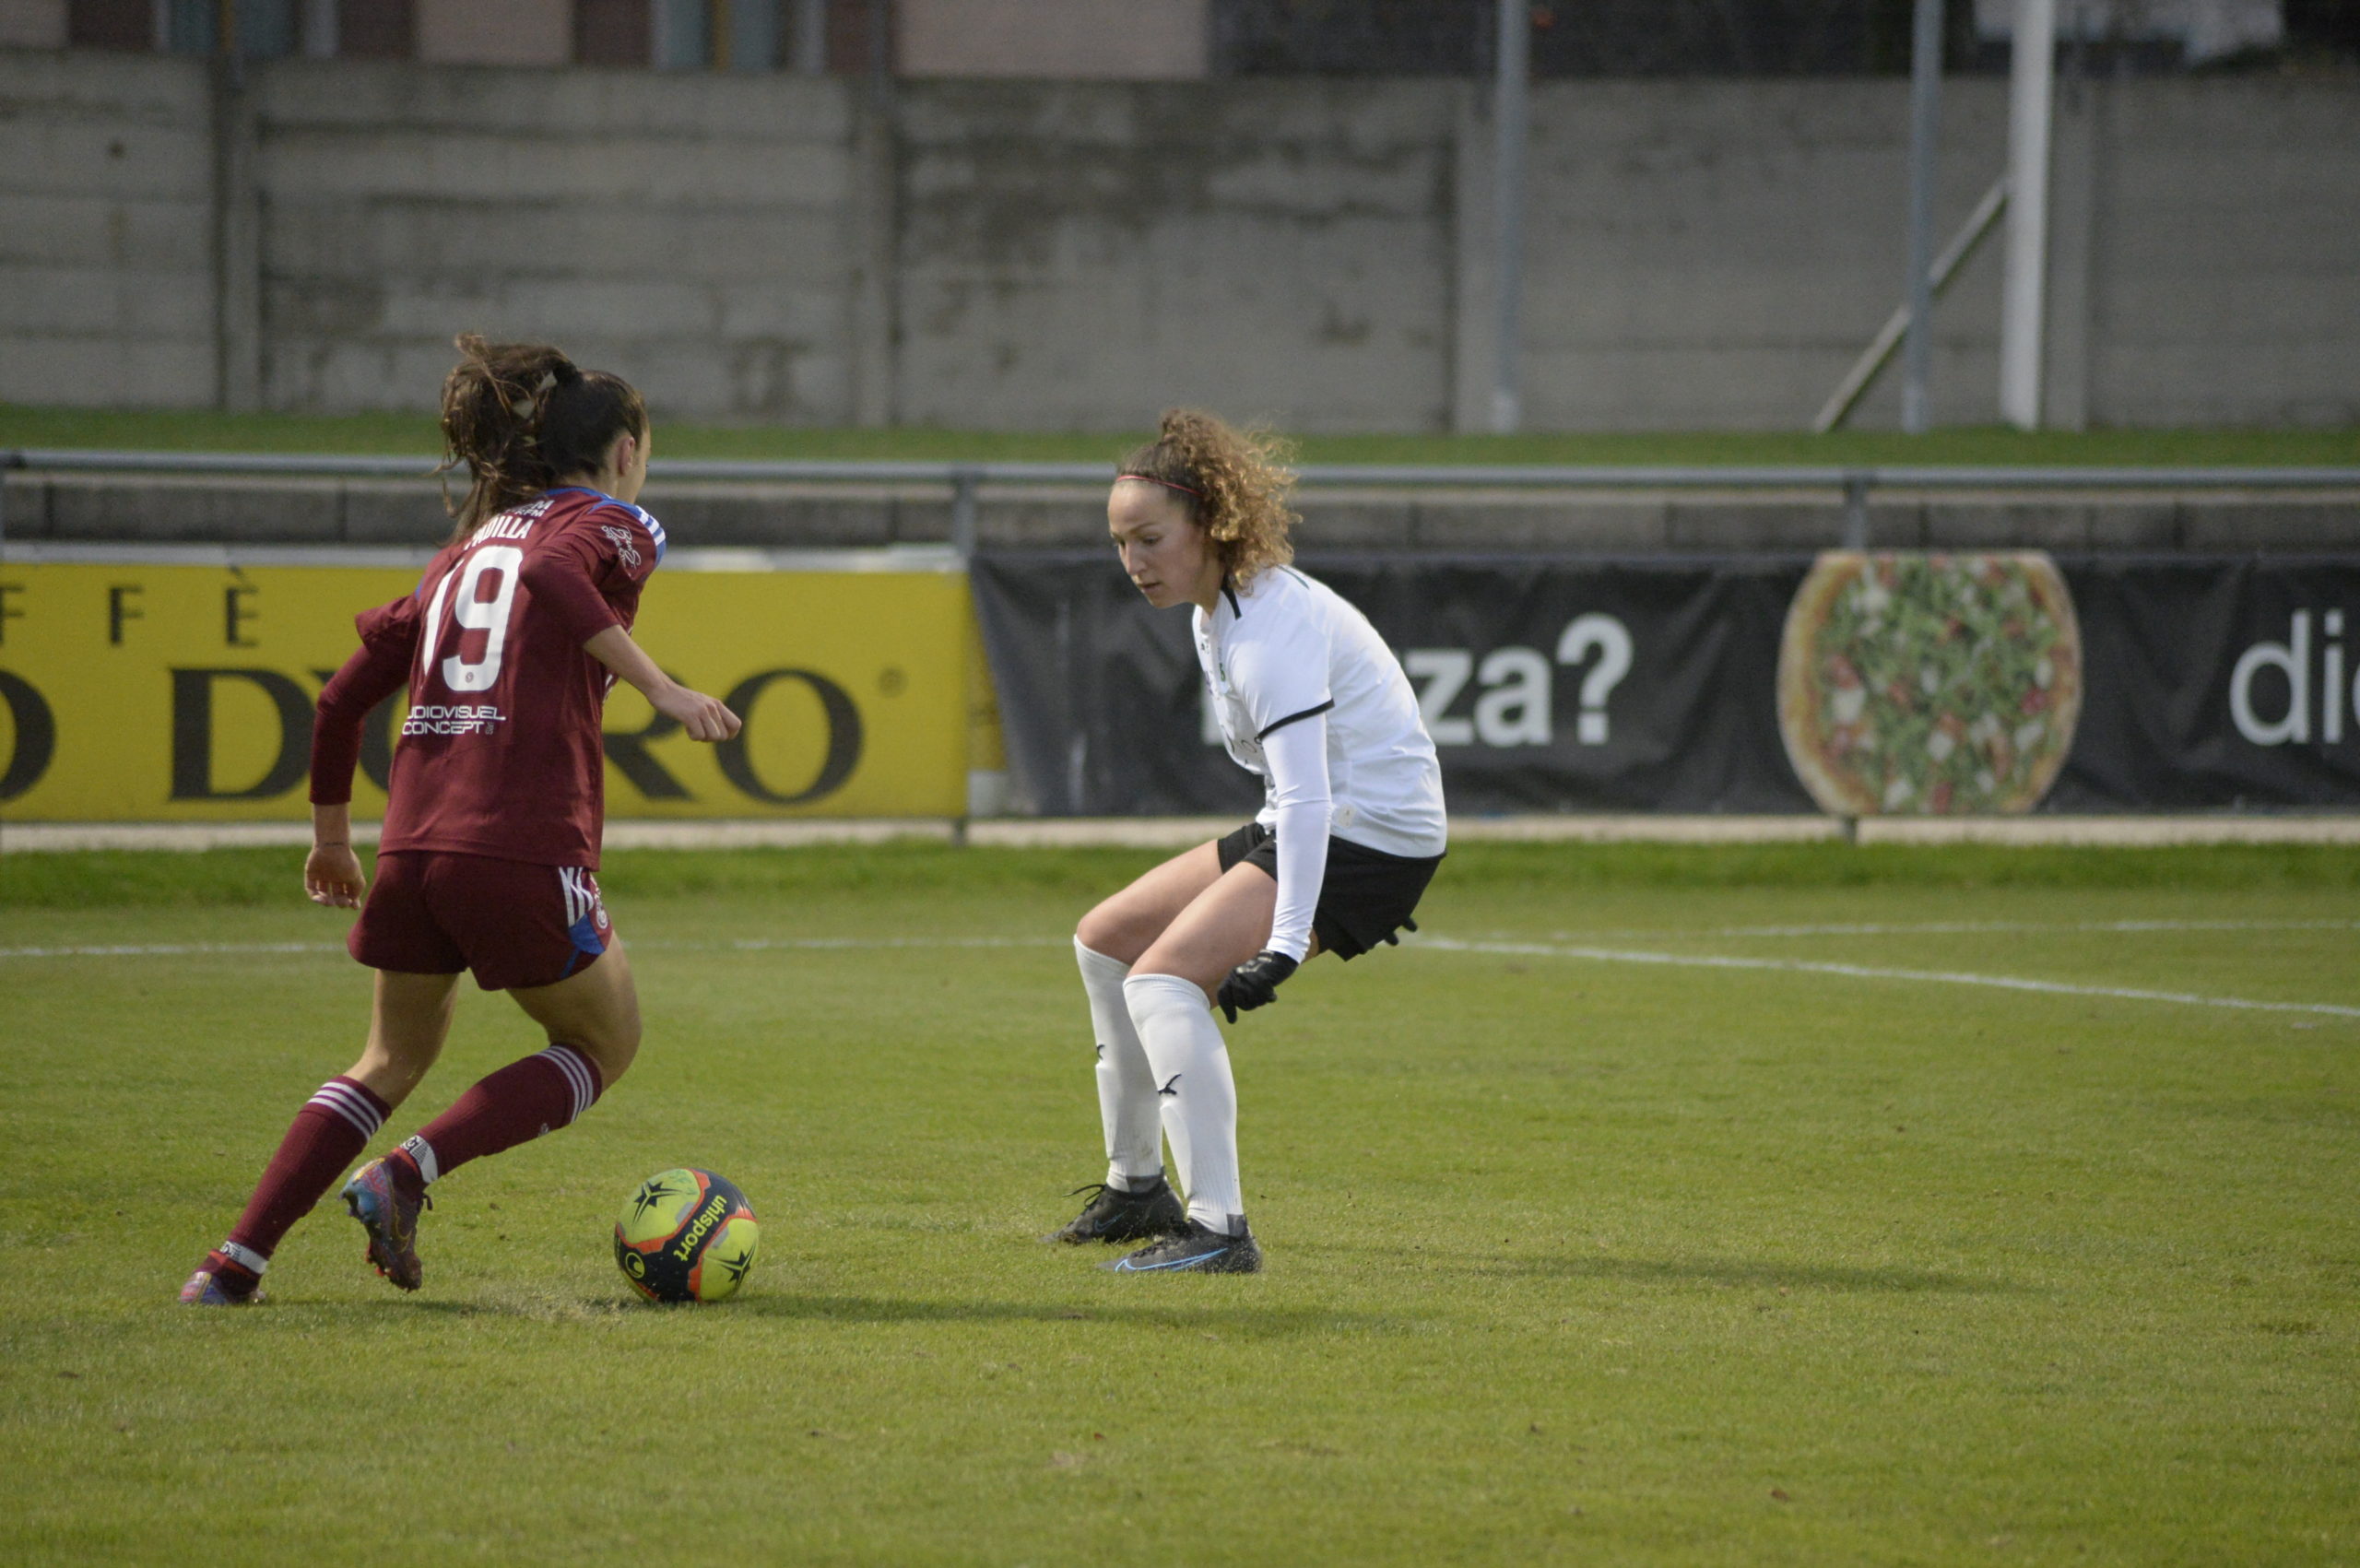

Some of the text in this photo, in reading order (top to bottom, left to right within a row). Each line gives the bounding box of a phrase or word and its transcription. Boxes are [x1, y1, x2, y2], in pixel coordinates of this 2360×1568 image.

[422, 545, 524, 692] 19
[2229, 607, 2360, 746] di
[402, 721, 485, 736] CONCEPT
[673, 1195, 727, 1262] uhlsport
